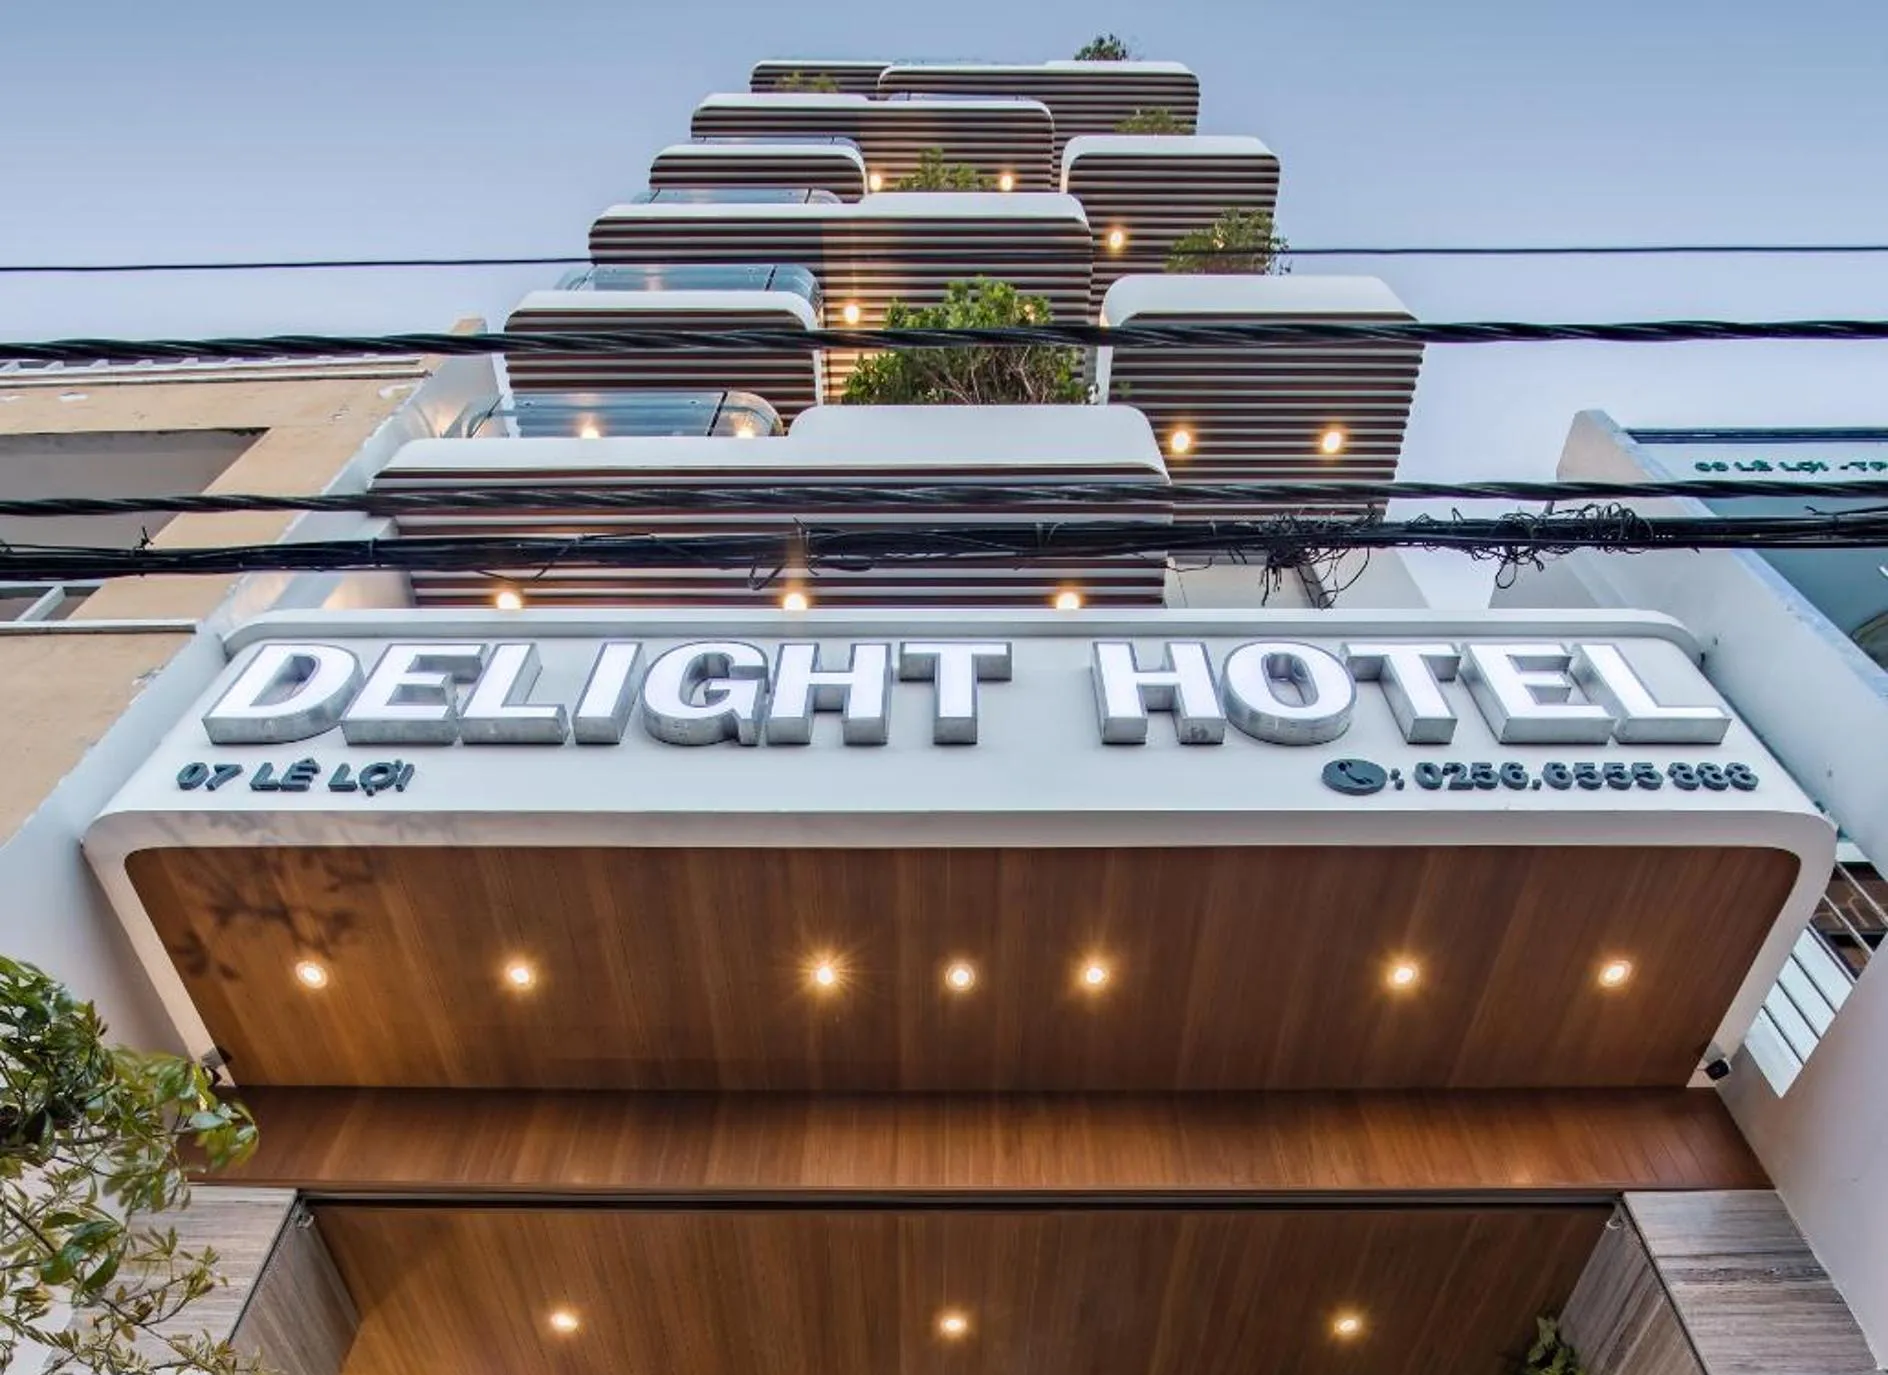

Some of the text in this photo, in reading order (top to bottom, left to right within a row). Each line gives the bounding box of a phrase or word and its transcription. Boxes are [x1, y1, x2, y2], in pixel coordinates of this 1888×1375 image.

[201, 640, 1733, 746] DELIGHT HOTEL
[176, 757, 415, 797] 07 LÊ LỢI
